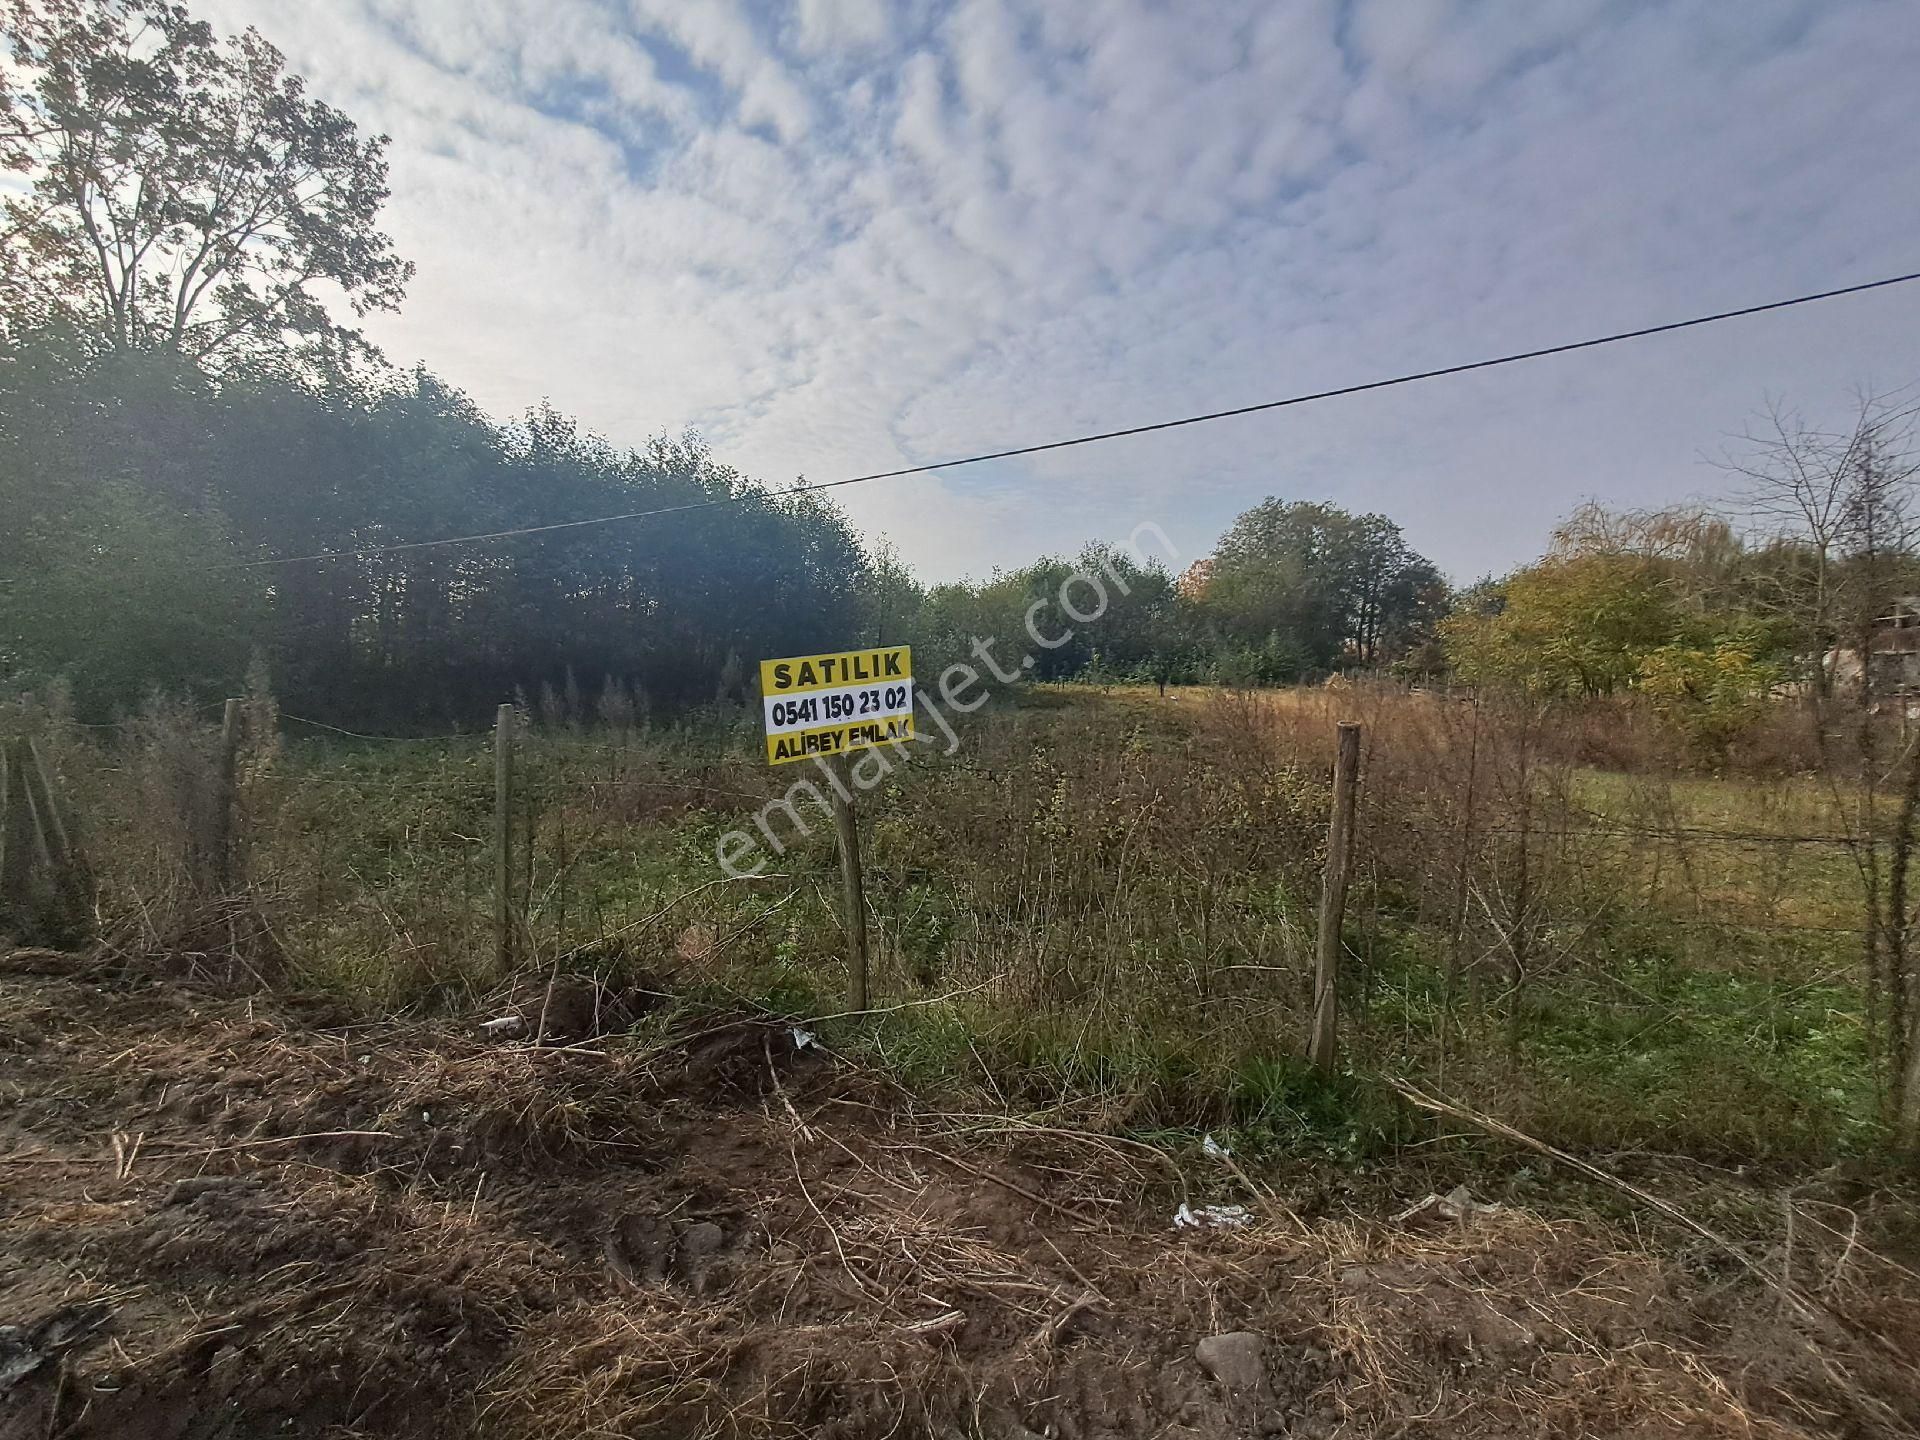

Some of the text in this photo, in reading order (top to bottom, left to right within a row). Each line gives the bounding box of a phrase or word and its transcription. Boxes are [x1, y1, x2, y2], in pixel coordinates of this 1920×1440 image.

[774, 652, 902, 689] SATILIK
[772, 686, 907, 727] 0541 150 23 02
[775, 719, 910, 760] ALİBEY EMLAK
